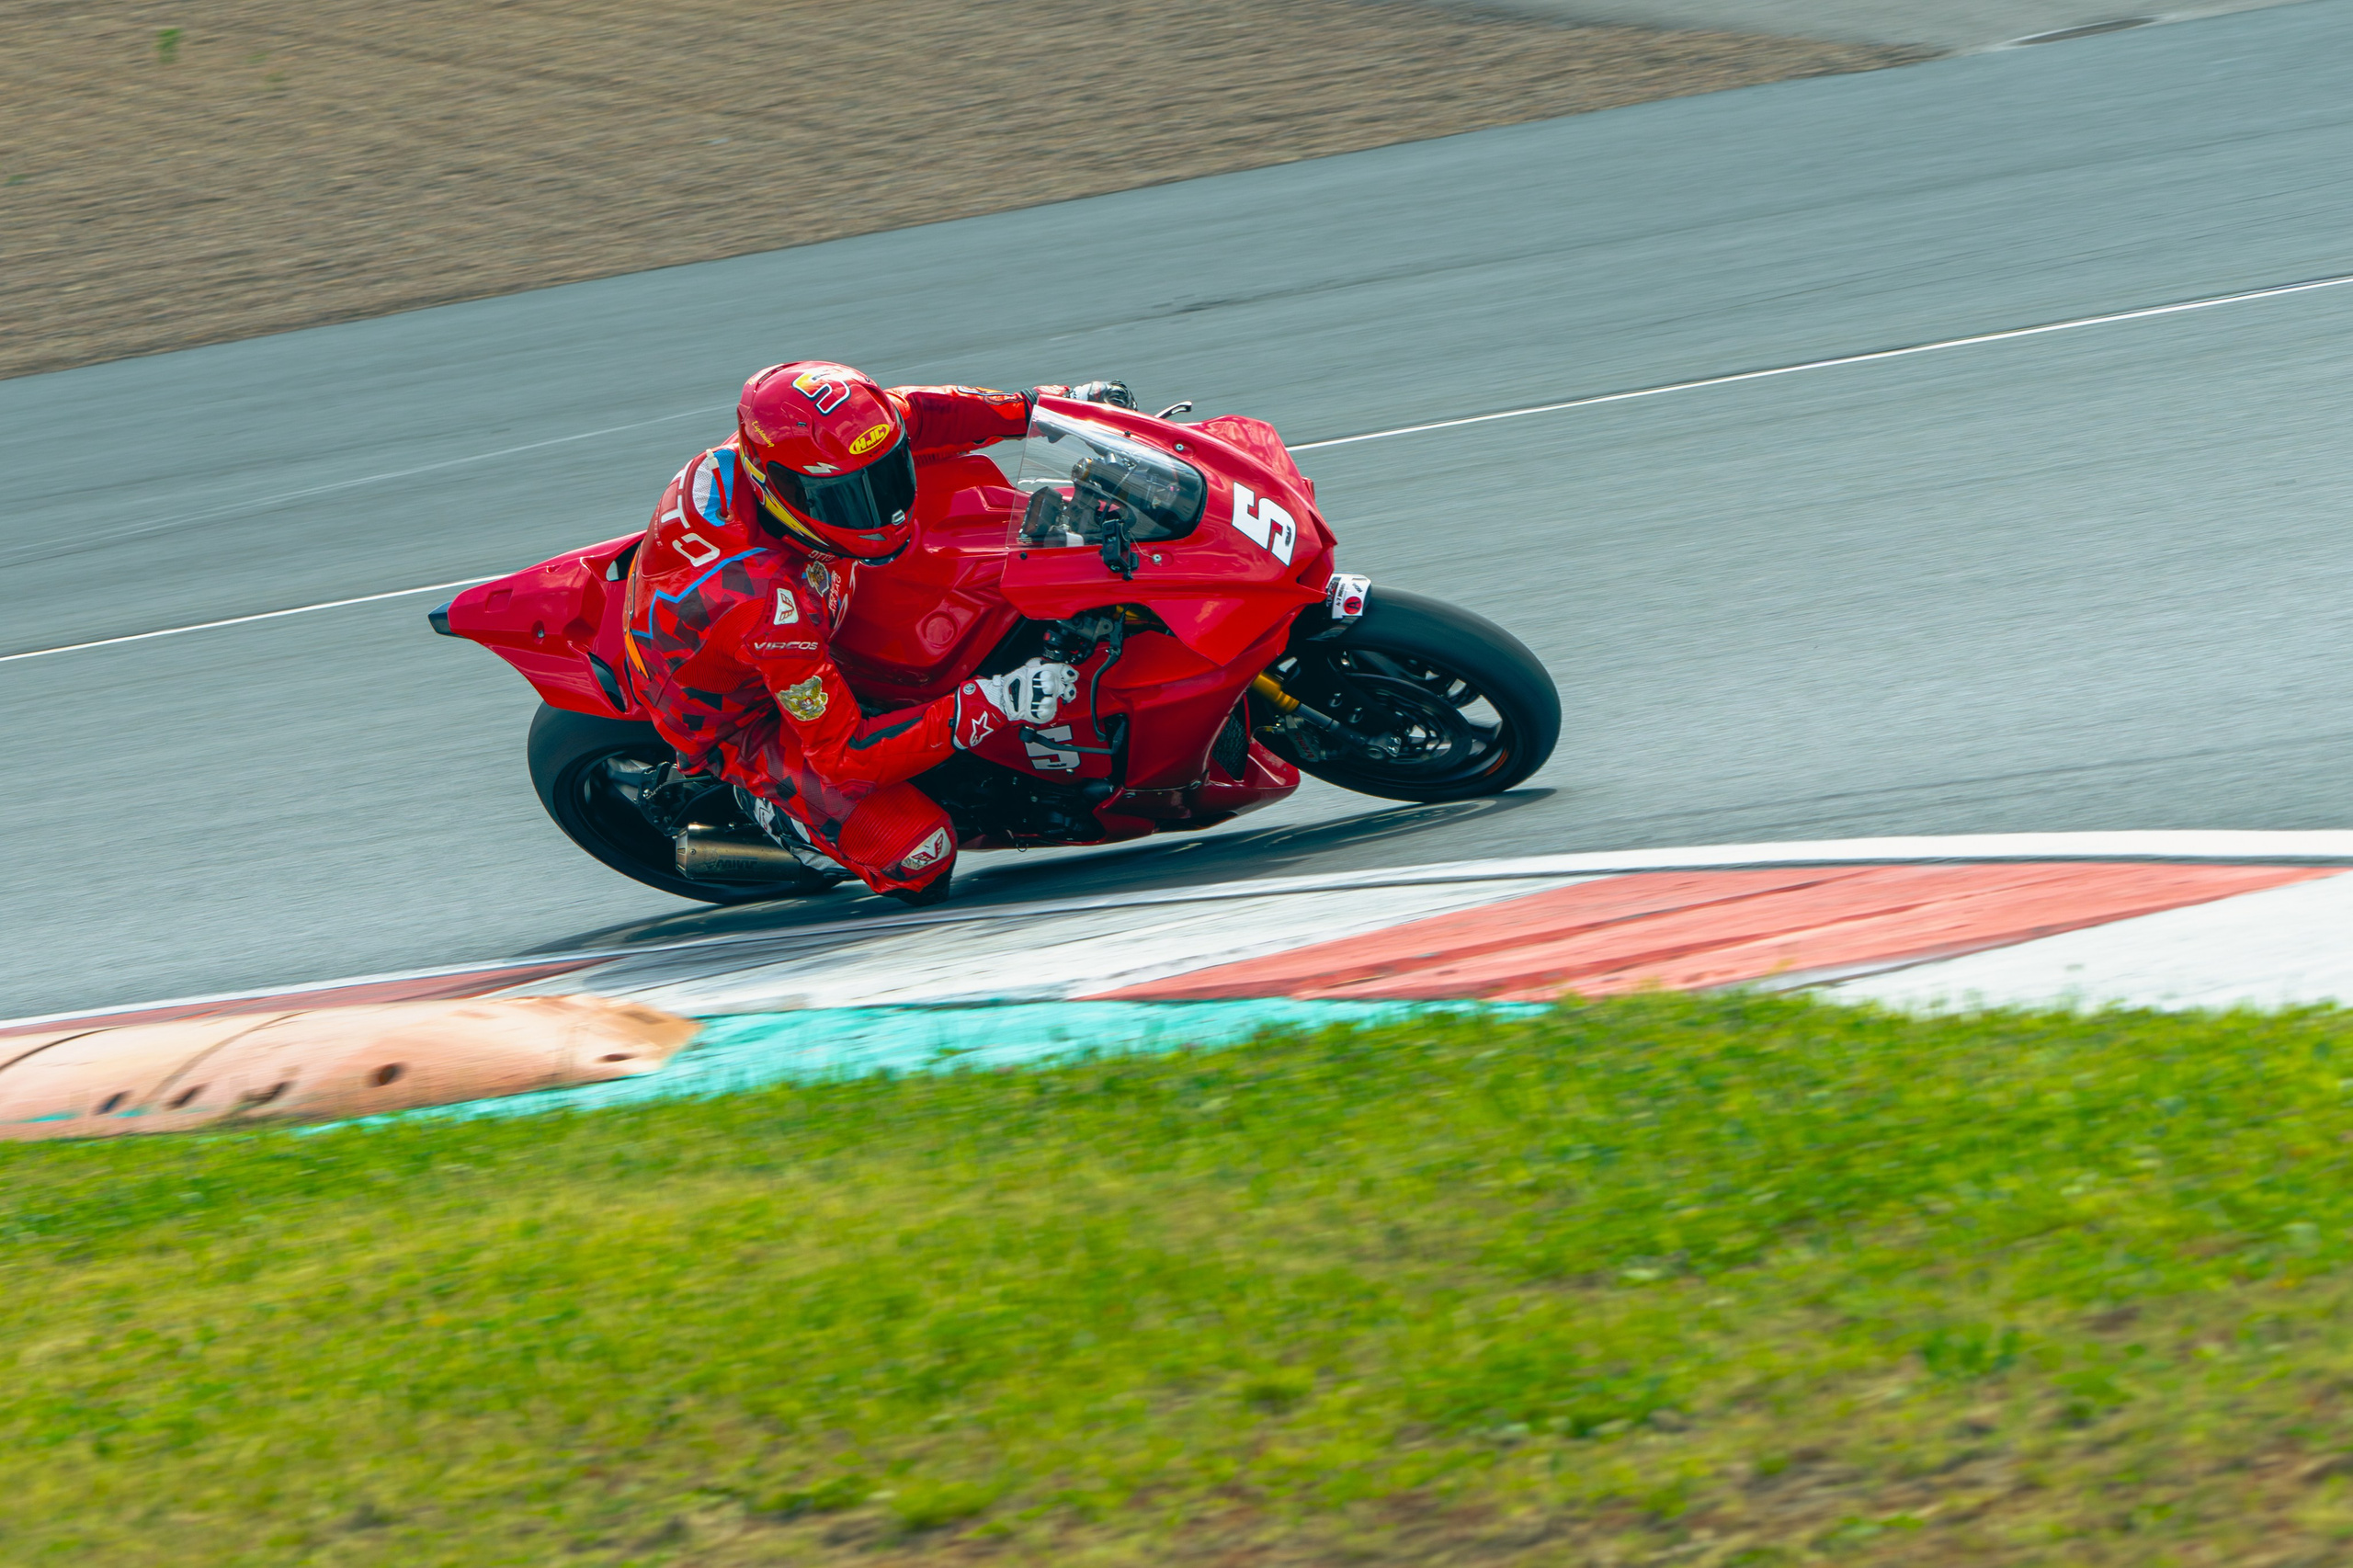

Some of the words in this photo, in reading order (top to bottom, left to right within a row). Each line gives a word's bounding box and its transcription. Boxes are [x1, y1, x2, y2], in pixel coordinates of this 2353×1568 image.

[751, 420, 775, 448] Lightning
[854, 426, 885, 452] HJC
[1231, 481, 1297, 567] 5
[754, 641, 819, 651] VIRCOS
[1024, 724, 1081, 770] 5
